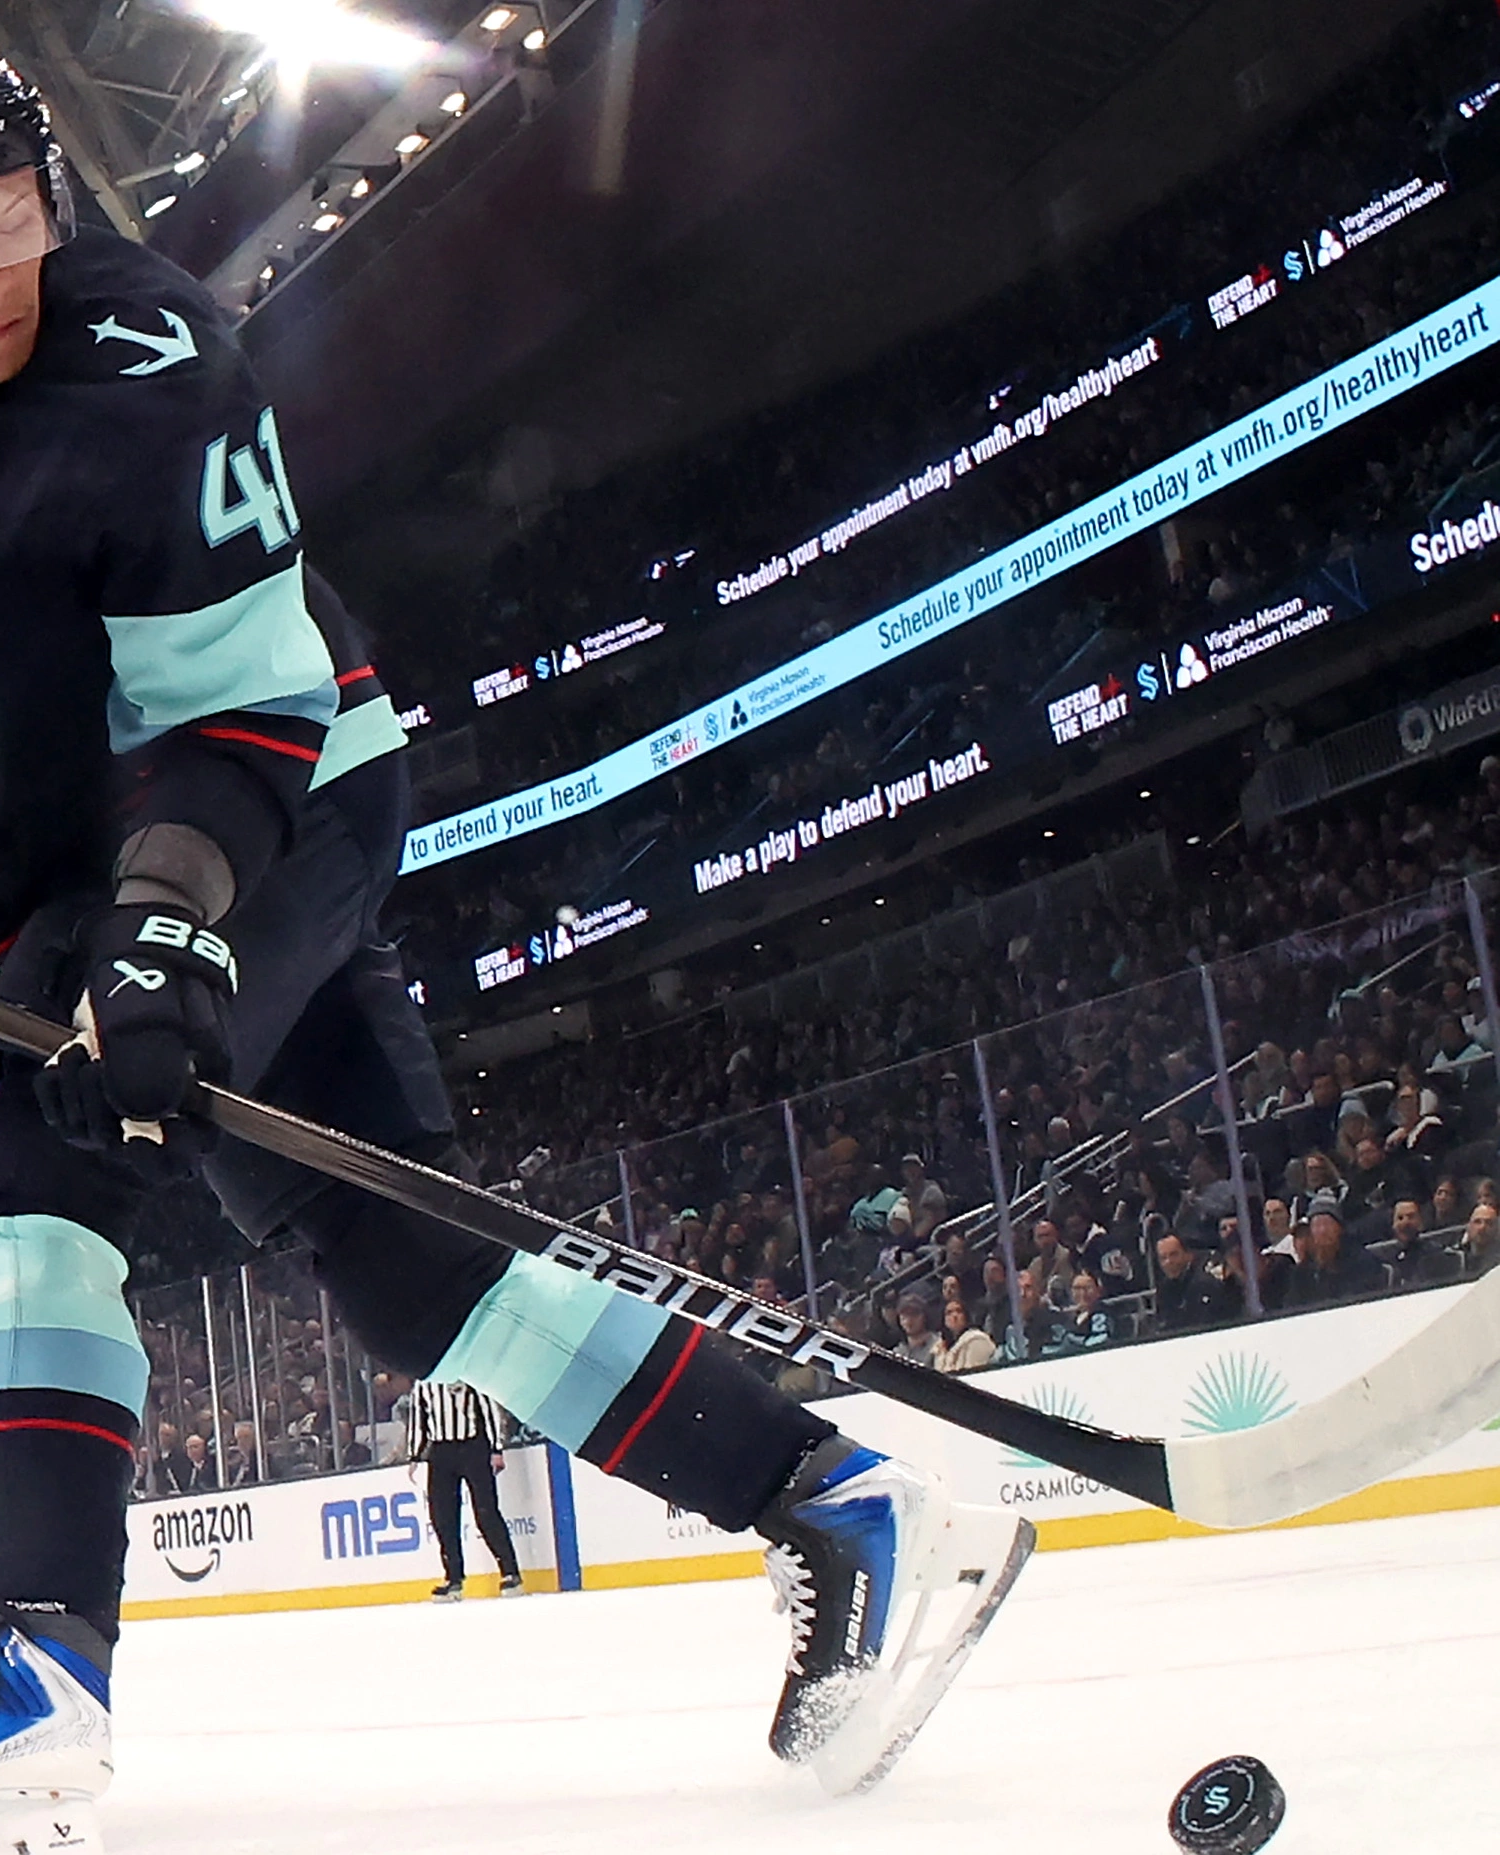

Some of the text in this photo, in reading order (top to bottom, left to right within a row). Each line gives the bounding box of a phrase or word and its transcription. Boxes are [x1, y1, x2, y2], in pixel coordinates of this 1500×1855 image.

[1208, 275, 1253, 313] DEFEND
[1212, 279, 1277, 330] THE HEART
[197, 403, 301, 556] 41
[717, 558, 788, 605] Schedule
[788, 538, 821, 576] your
[821, 483, 910, 552] appointment
[909, 461, 953, 502] today
[954, 453, 972, 476] at
[972, 336, 1160, 465] vmfh.org/healthyheart
[877, 302, 1490, 650] Schedule your appointment today at vmfh.org/healthyheart
[1204, 598, 1303, 651] Virginia Mason
[1209, 605, 1328, 673] Franciscan Health
[1048, 684, 1100, 726] DEFEND
[1052, 694, 1128, 746] THE HEART
[669, 737, 699, 762] HEART
[410, 773, 604, 861] to defend your heart.
[694, 742, 990, 894] Make a play to defend your heart.
[542, 1231, 870, 1383] BAUER
[153, 1501, 254, 1549] amazon
[321, 1492, 421, 1560] MPS
[844, 1569, 870, 1657] BAUER
